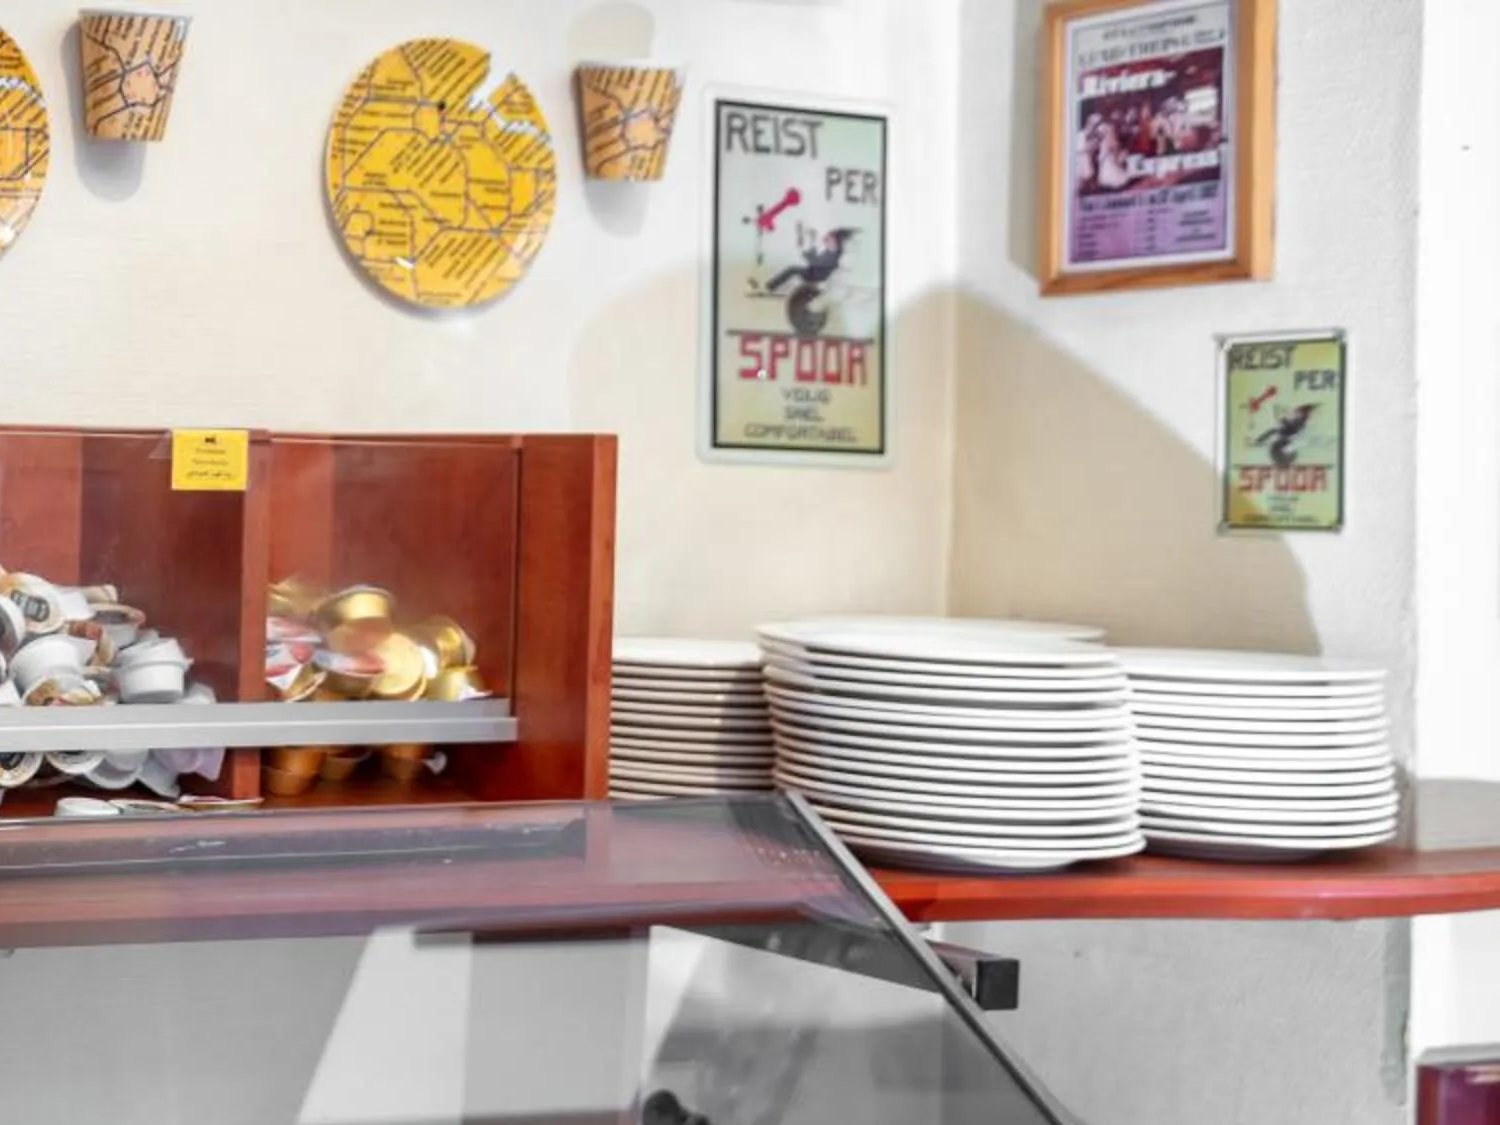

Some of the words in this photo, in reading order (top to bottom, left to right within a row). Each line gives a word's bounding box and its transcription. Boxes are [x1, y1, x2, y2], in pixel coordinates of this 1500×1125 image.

[725, 111, 825, 160] REIST
[825, 166, 879, 205] PER
[738, 333, 868, 386] SPOOR
[1228, 347, 1292, 371] REIST
[1293, 370, 1338, 391] PER
[1238, 466, 1328, 493] SPOOR
